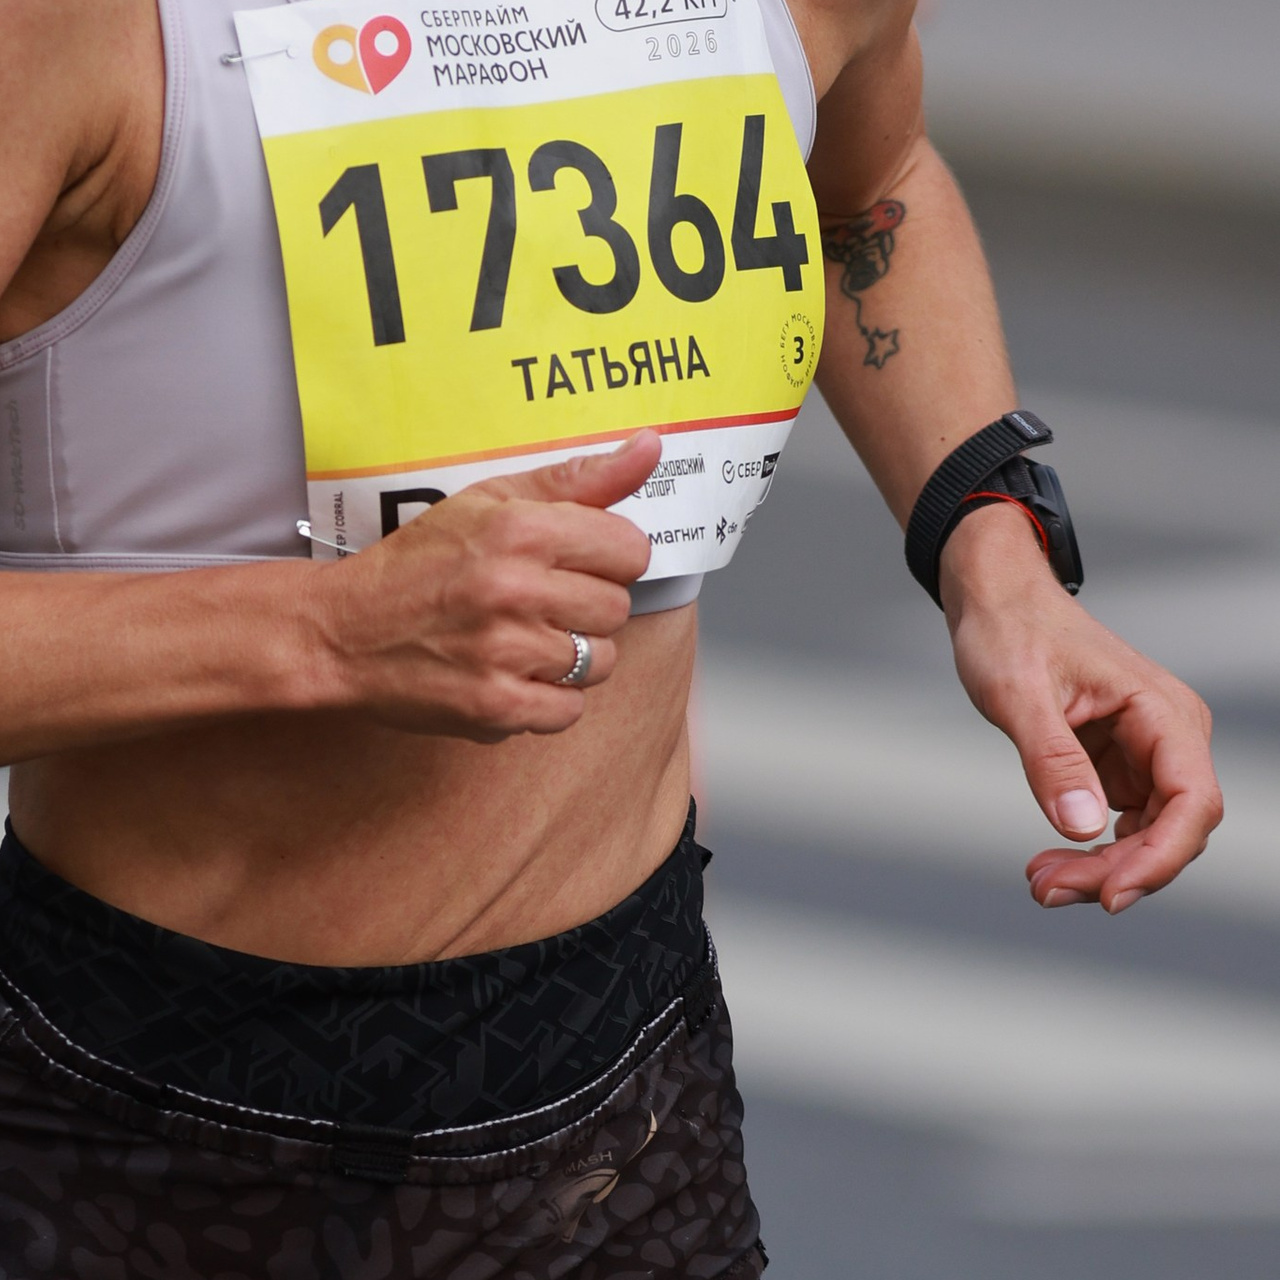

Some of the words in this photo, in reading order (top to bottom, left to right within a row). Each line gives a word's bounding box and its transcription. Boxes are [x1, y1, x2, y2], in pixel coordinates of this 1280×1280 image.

[420, 5, 529, 29] СБЕРПРАЙМ
[425, 19, 587, 58] МОСКОВСКИЙ
[645, 29, 718, 61] 2026
[432, 58, 549, 87] МАРАФОН
[318, 114, 810, 347] 17364
[793, 336, 805, 365] 3
[511, 335, 711, 402] ТАТЬЯНА
[737, 461, 762, 478] СБЕР
[644, 478, 677, 498] СПОРТ
[565, 1150, 613, 1174] MASH
